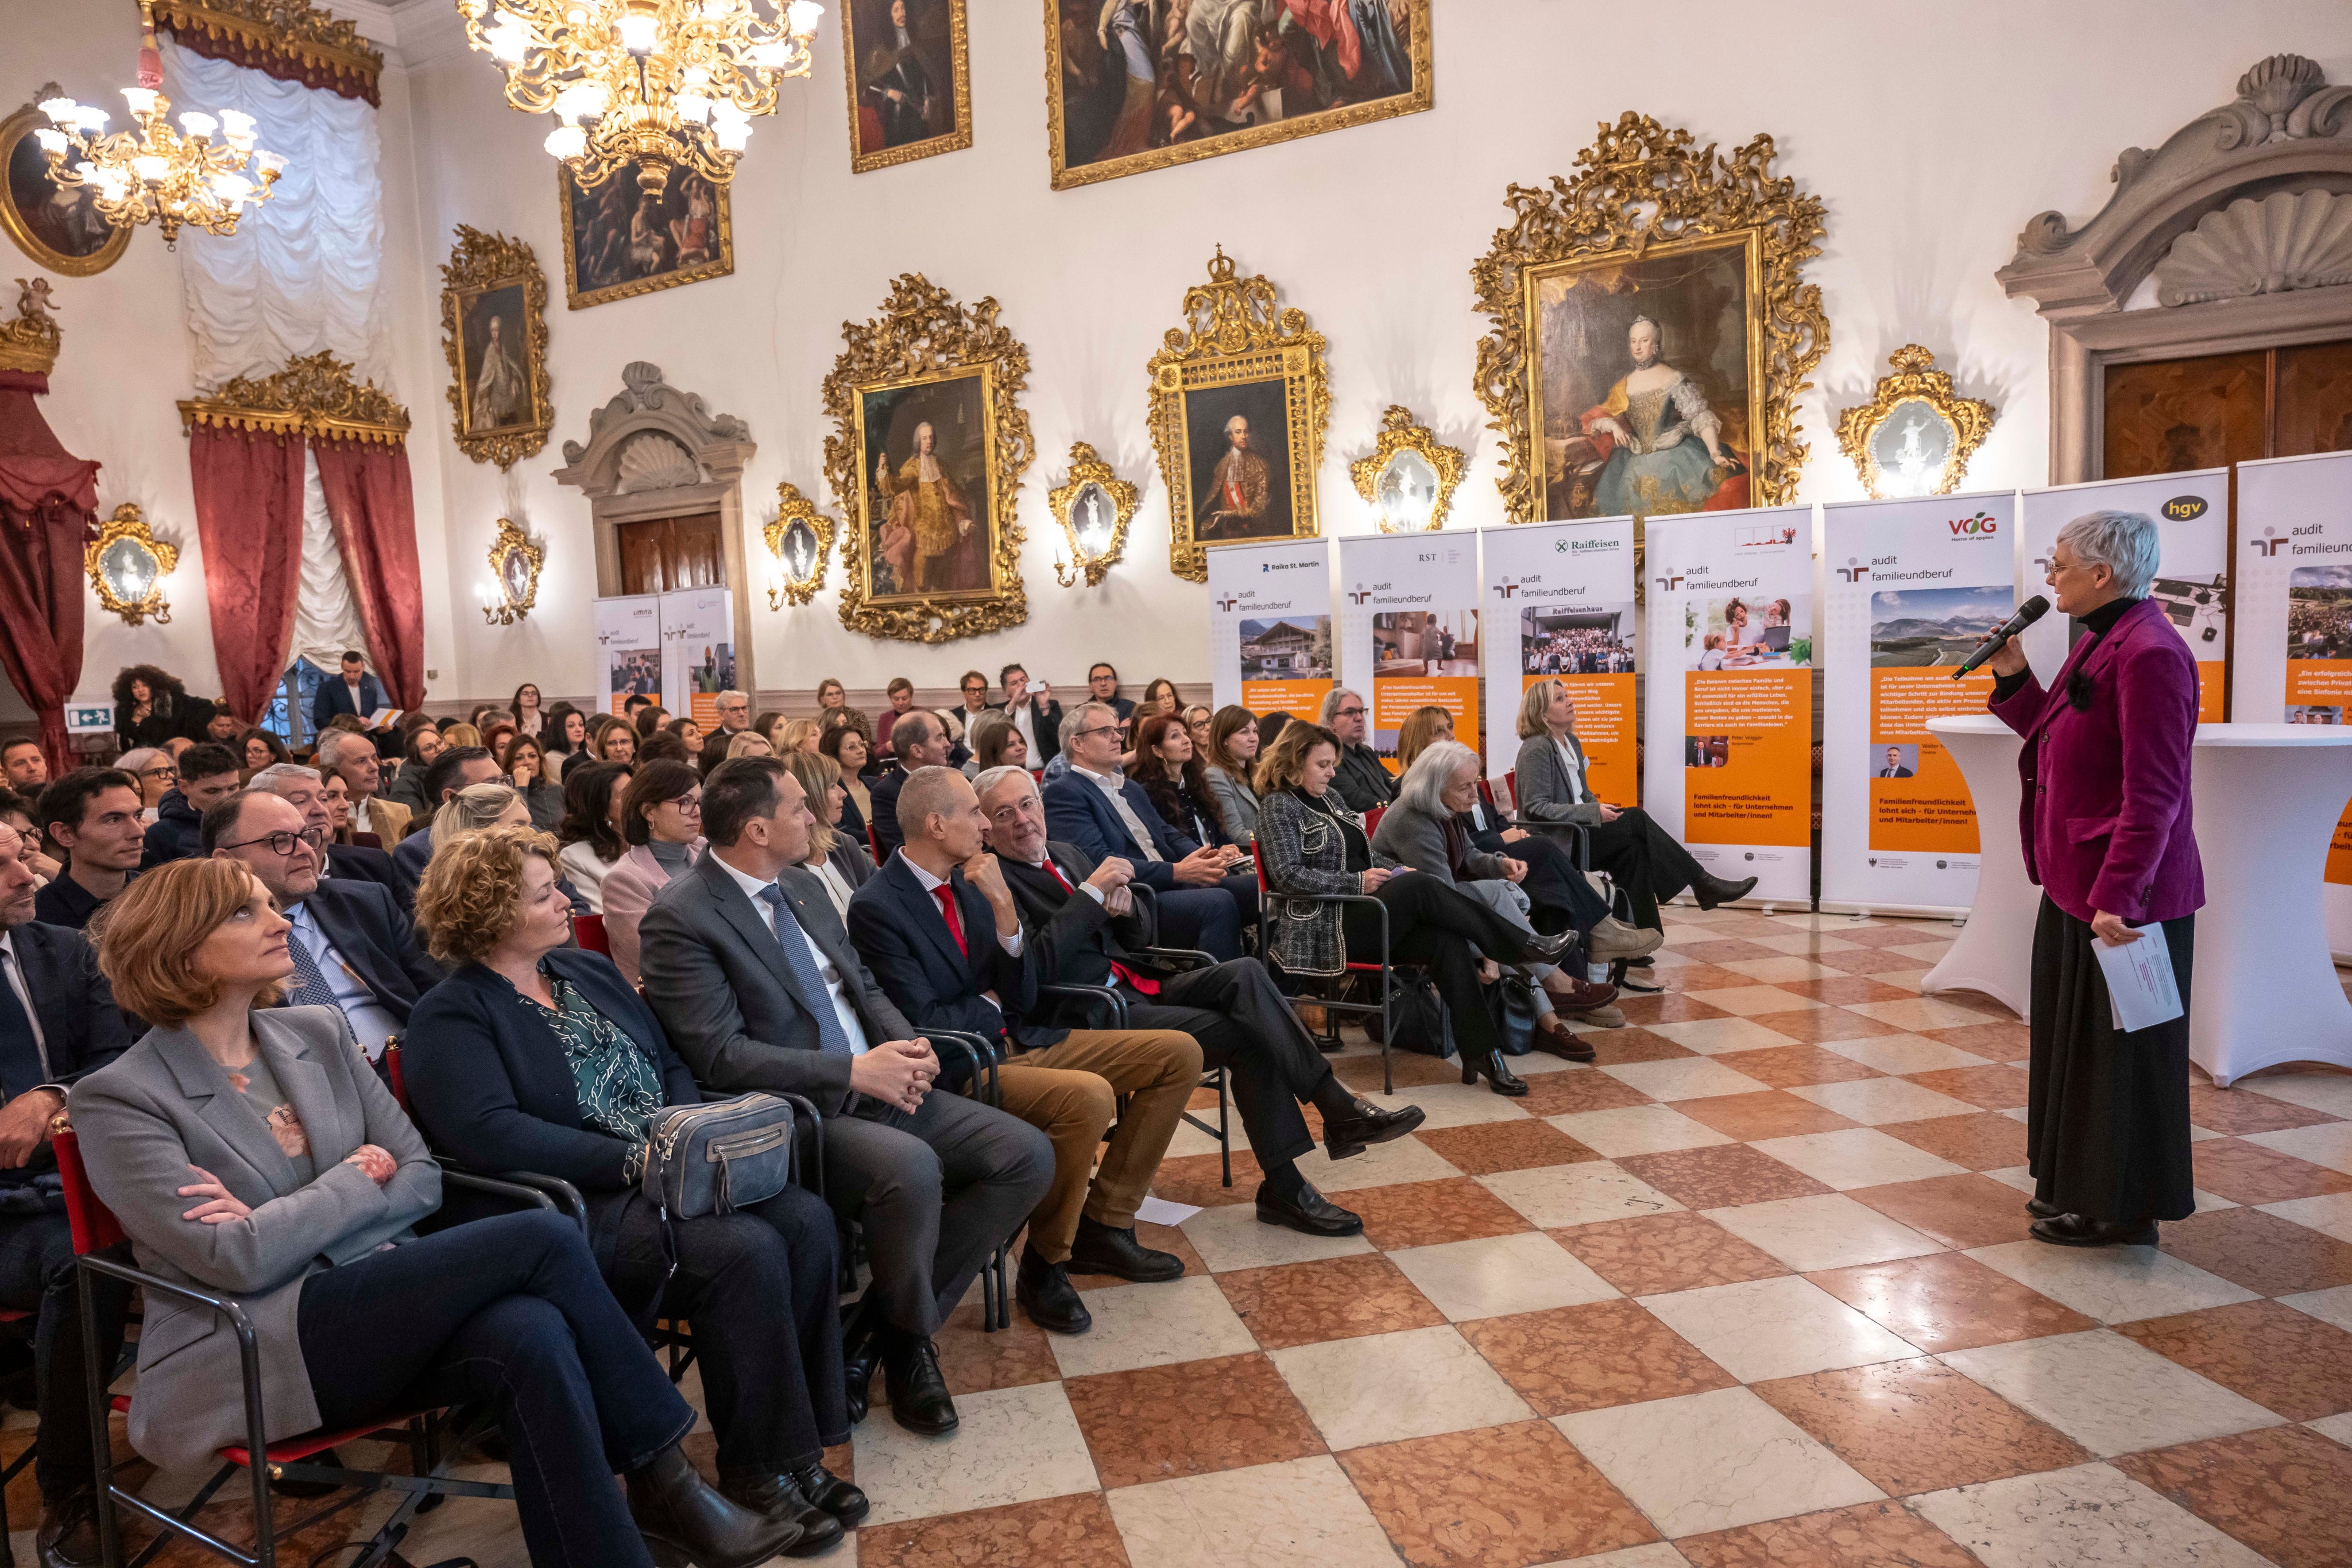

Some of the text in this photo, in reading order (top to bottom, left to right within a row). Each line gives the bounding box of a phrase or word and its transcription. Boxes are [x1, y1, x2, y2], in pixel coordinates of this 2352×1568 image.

[2169, 502, 2201, 518] hgv
[1948, 517, 1996, 535] VOG
[2292, 524, 2323, 536] audit
[1572, 540, 1619, 549] Raiffeisen
[1871, 556, 1897, 566] audit
[1686, 566, 1709, 575] audit
[1872, 568, 1953, 581] familieundberuf
[1521, 575, 1541, 583] audit
[1686, 578, 1758, 590] familieundberuf
[1521, 587, 1586, 598] familieundberuf
[1374, 594, 1432, 603] familieundberuf
[1239, 601, 1291, 611] familieundberuf
[1552, 606, 1603, 615] Raiffeisenhaus
